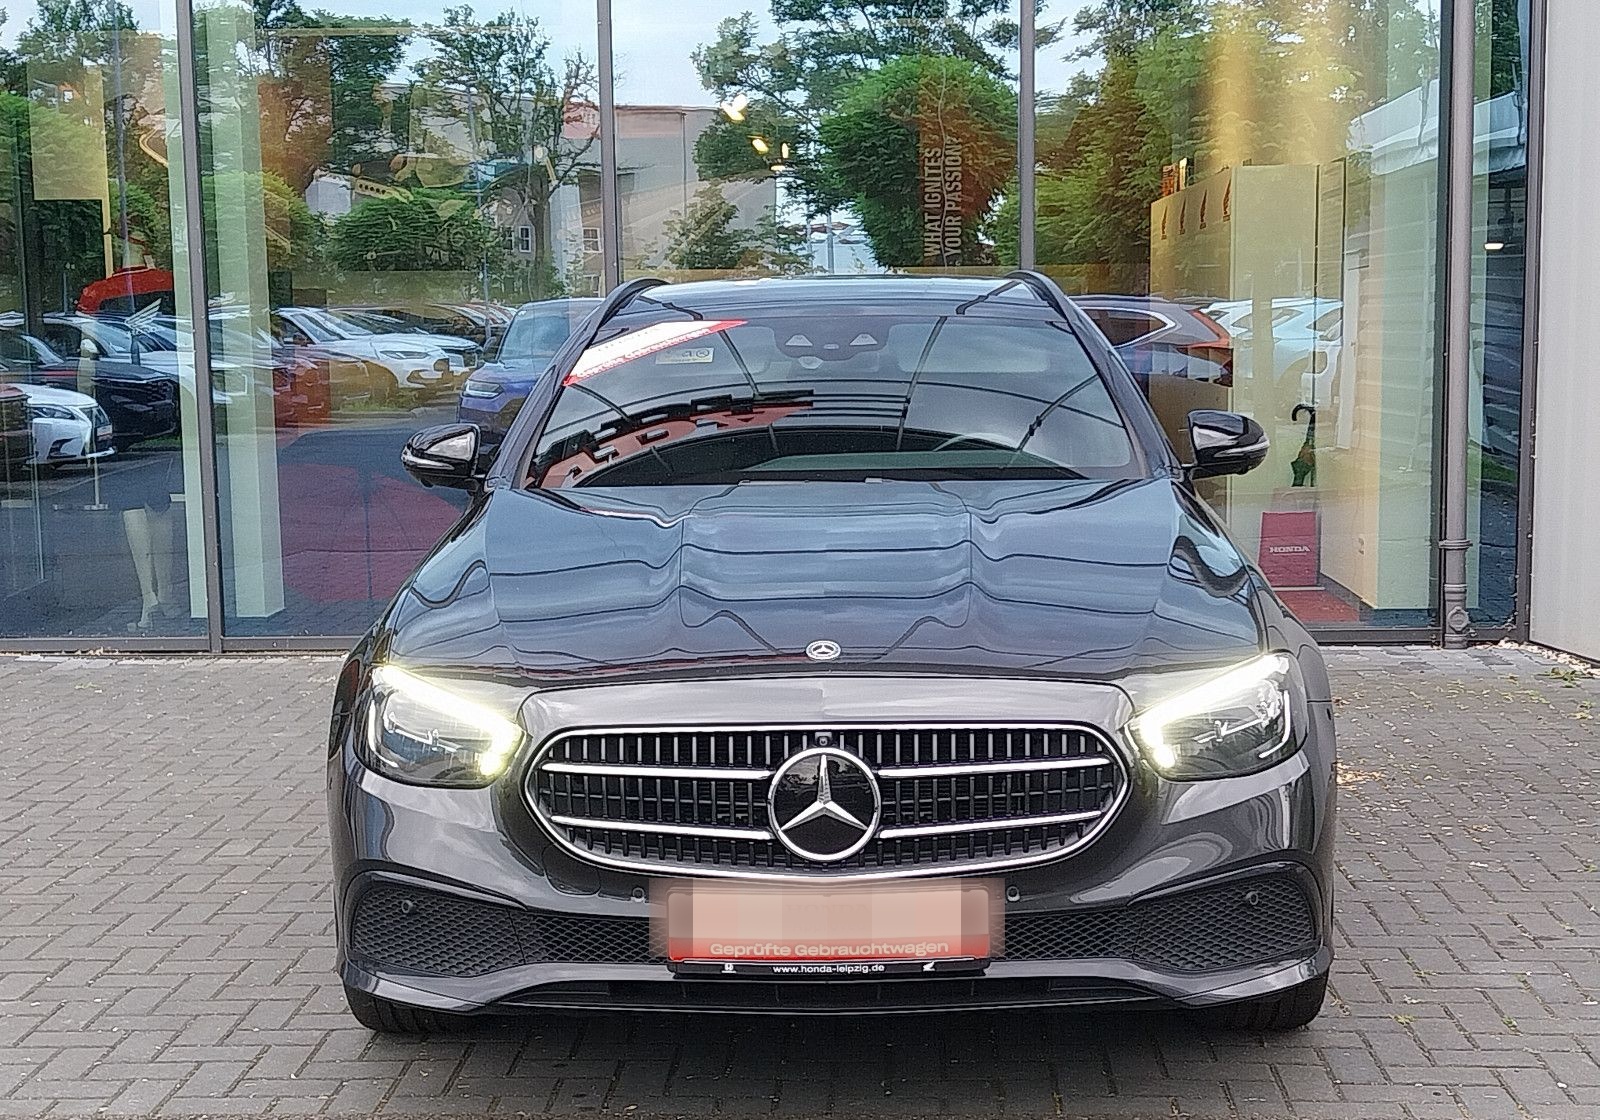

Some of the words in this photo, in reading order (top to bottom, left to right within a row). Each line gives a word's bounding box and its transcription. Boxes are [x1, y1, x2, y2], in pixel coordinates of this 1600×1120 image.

[924, 147, 942, 208] IGNITES
[924, 212, 942, 257] WHAT
[944, 216, 962, 257] YOUR
[710, 943, 791, 958] Geprüfte
[794, 942, 949, 957] Gebrauchtwagen
[772, 964, 885, 974] www.honda-leipzig.de
